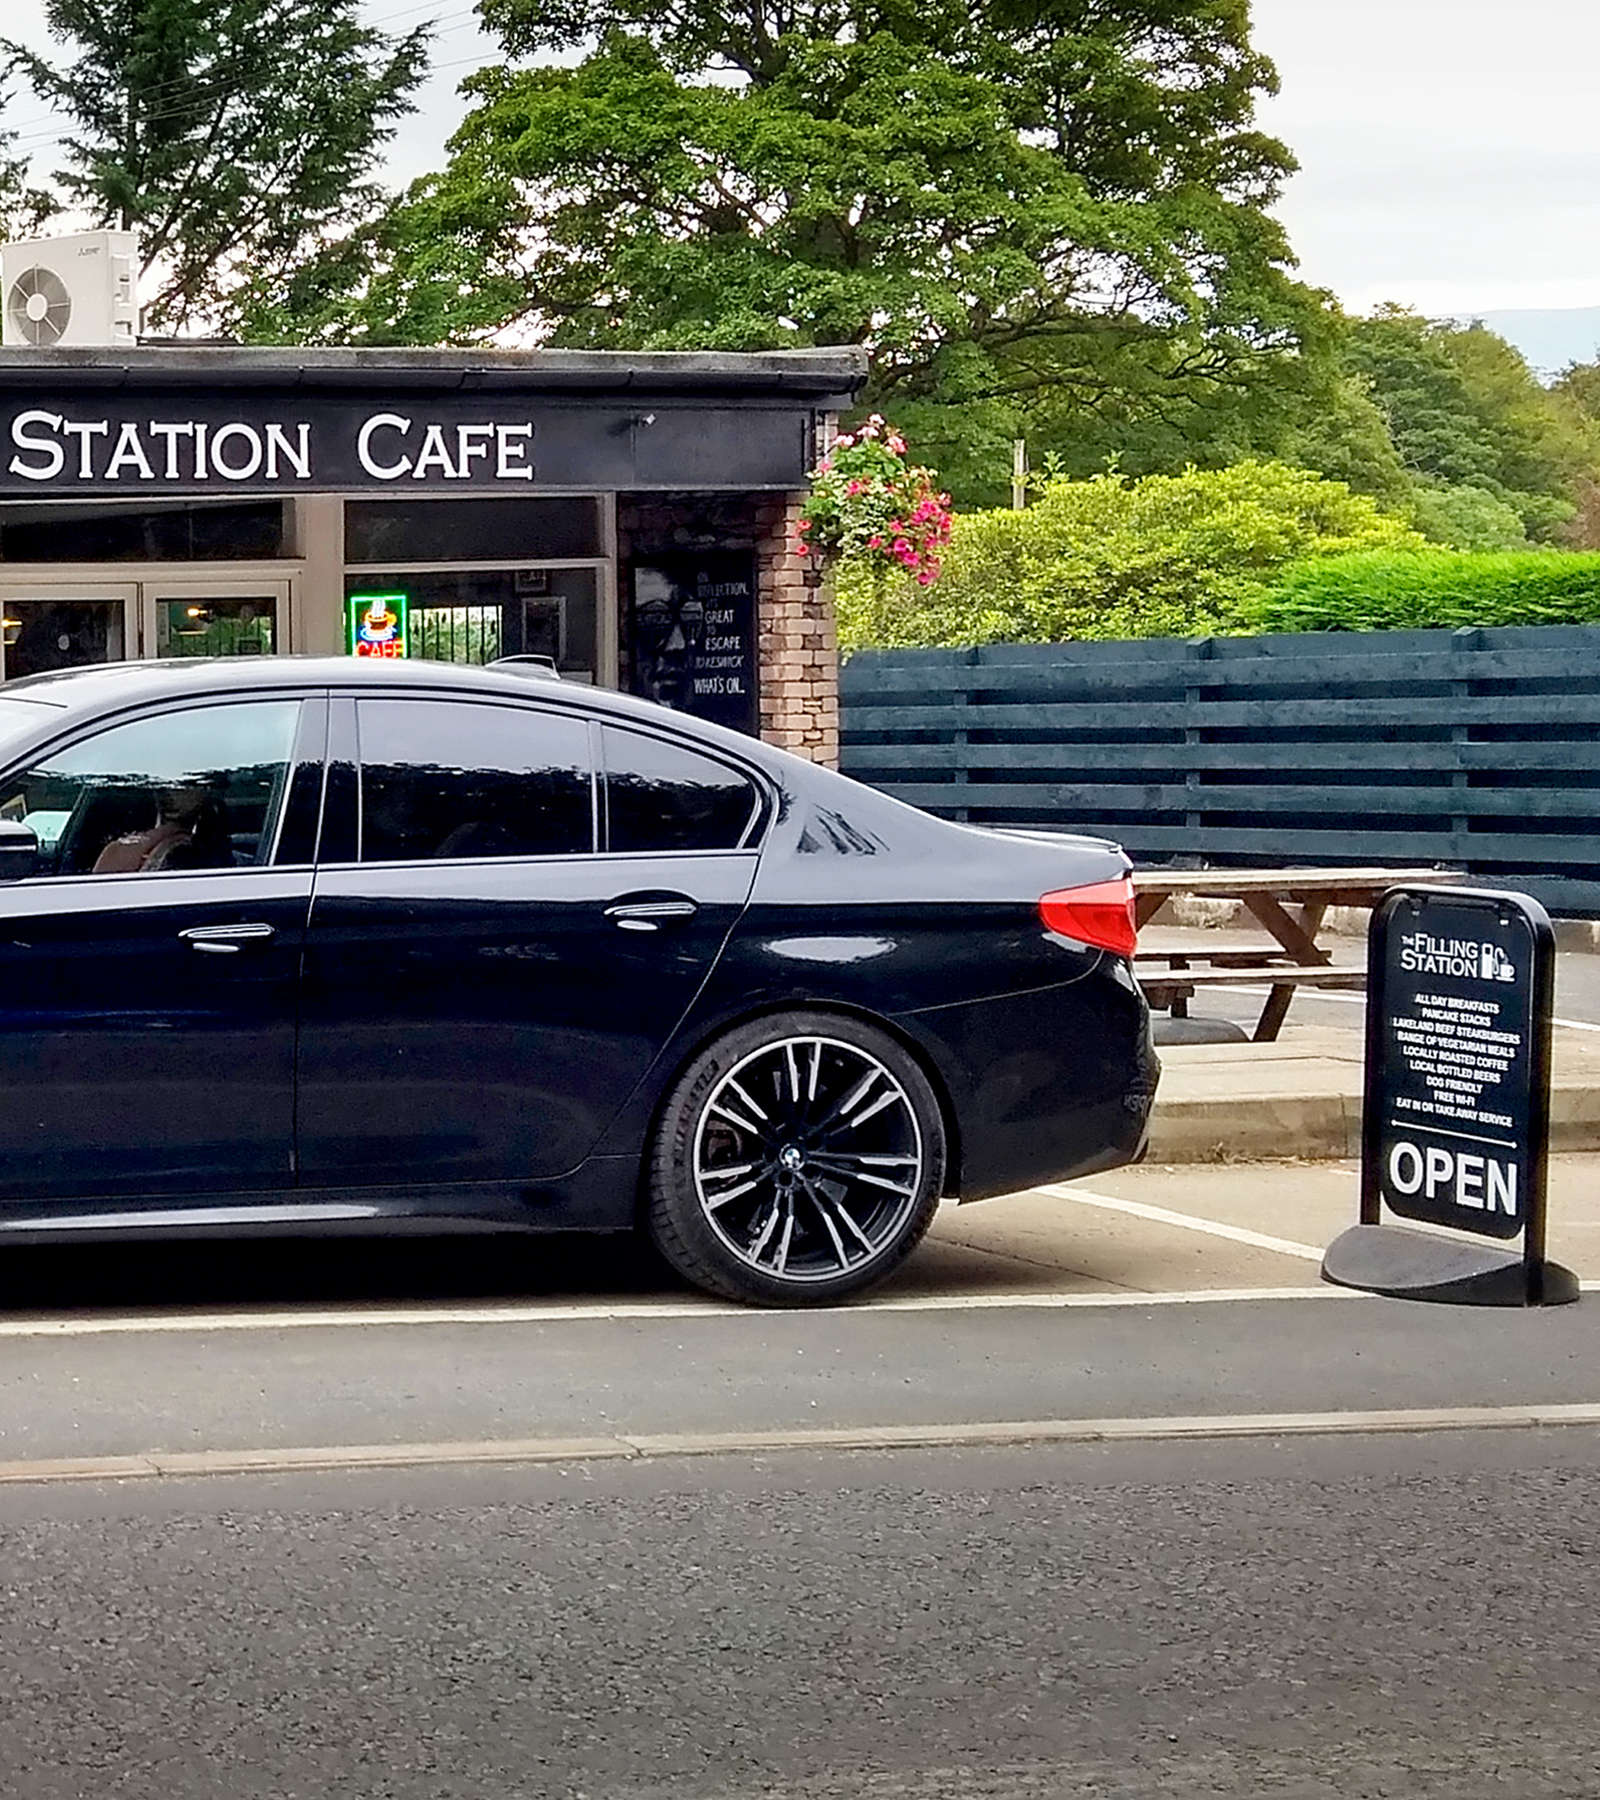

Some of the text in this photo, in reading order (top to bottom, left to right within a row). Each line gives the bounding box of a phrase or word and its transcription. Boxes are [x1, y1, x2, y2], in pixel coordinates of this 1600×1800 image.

[8, 409, 311, 480] STATION
[357, 412, 534, 481] CAFE
[704, 609, 735, 625] GREAT
[357, 641, 403, 658] CAFE
[705, 636, 741, 651] ESCAPE
[693, 675, 725, 694] WHAT'S
[1414, 932, 1479, 959] FILLING
[1400, 948, 1478, 978] STATION
[1415, 993, 1500, 1014] ALL DAY BREAKFASTS
[1393, 1017, 1434, 1032] LAKELAND
[1435, 1023, 1456, 1034] BEEF
[1422, 1007, 1491, 1027] PANCAKE STACKS
[1397, 1031, 1515, 1058] RANGE OF VEGETARIAN MEALS
[1403, 1045, 1509, 1071] LOCALLY ROASTED COFFEE
[1410, 1060, 1501, 1084] LOCAL BOTTLED BEERS
[1426, 1075, 1483, 1094] DOG FRIENDLY
[1433, 1090, 1455, 1103] FREE
[1396, 1097, 1412, 1109] EAT
[1412, 1100, 1421, 1110] IN
[1422, 1101, 1434, 1113] OR
[1478, 1111, 1513, 1128] SERVICE
[1389, 1141, 1517, 1216] OPEN
